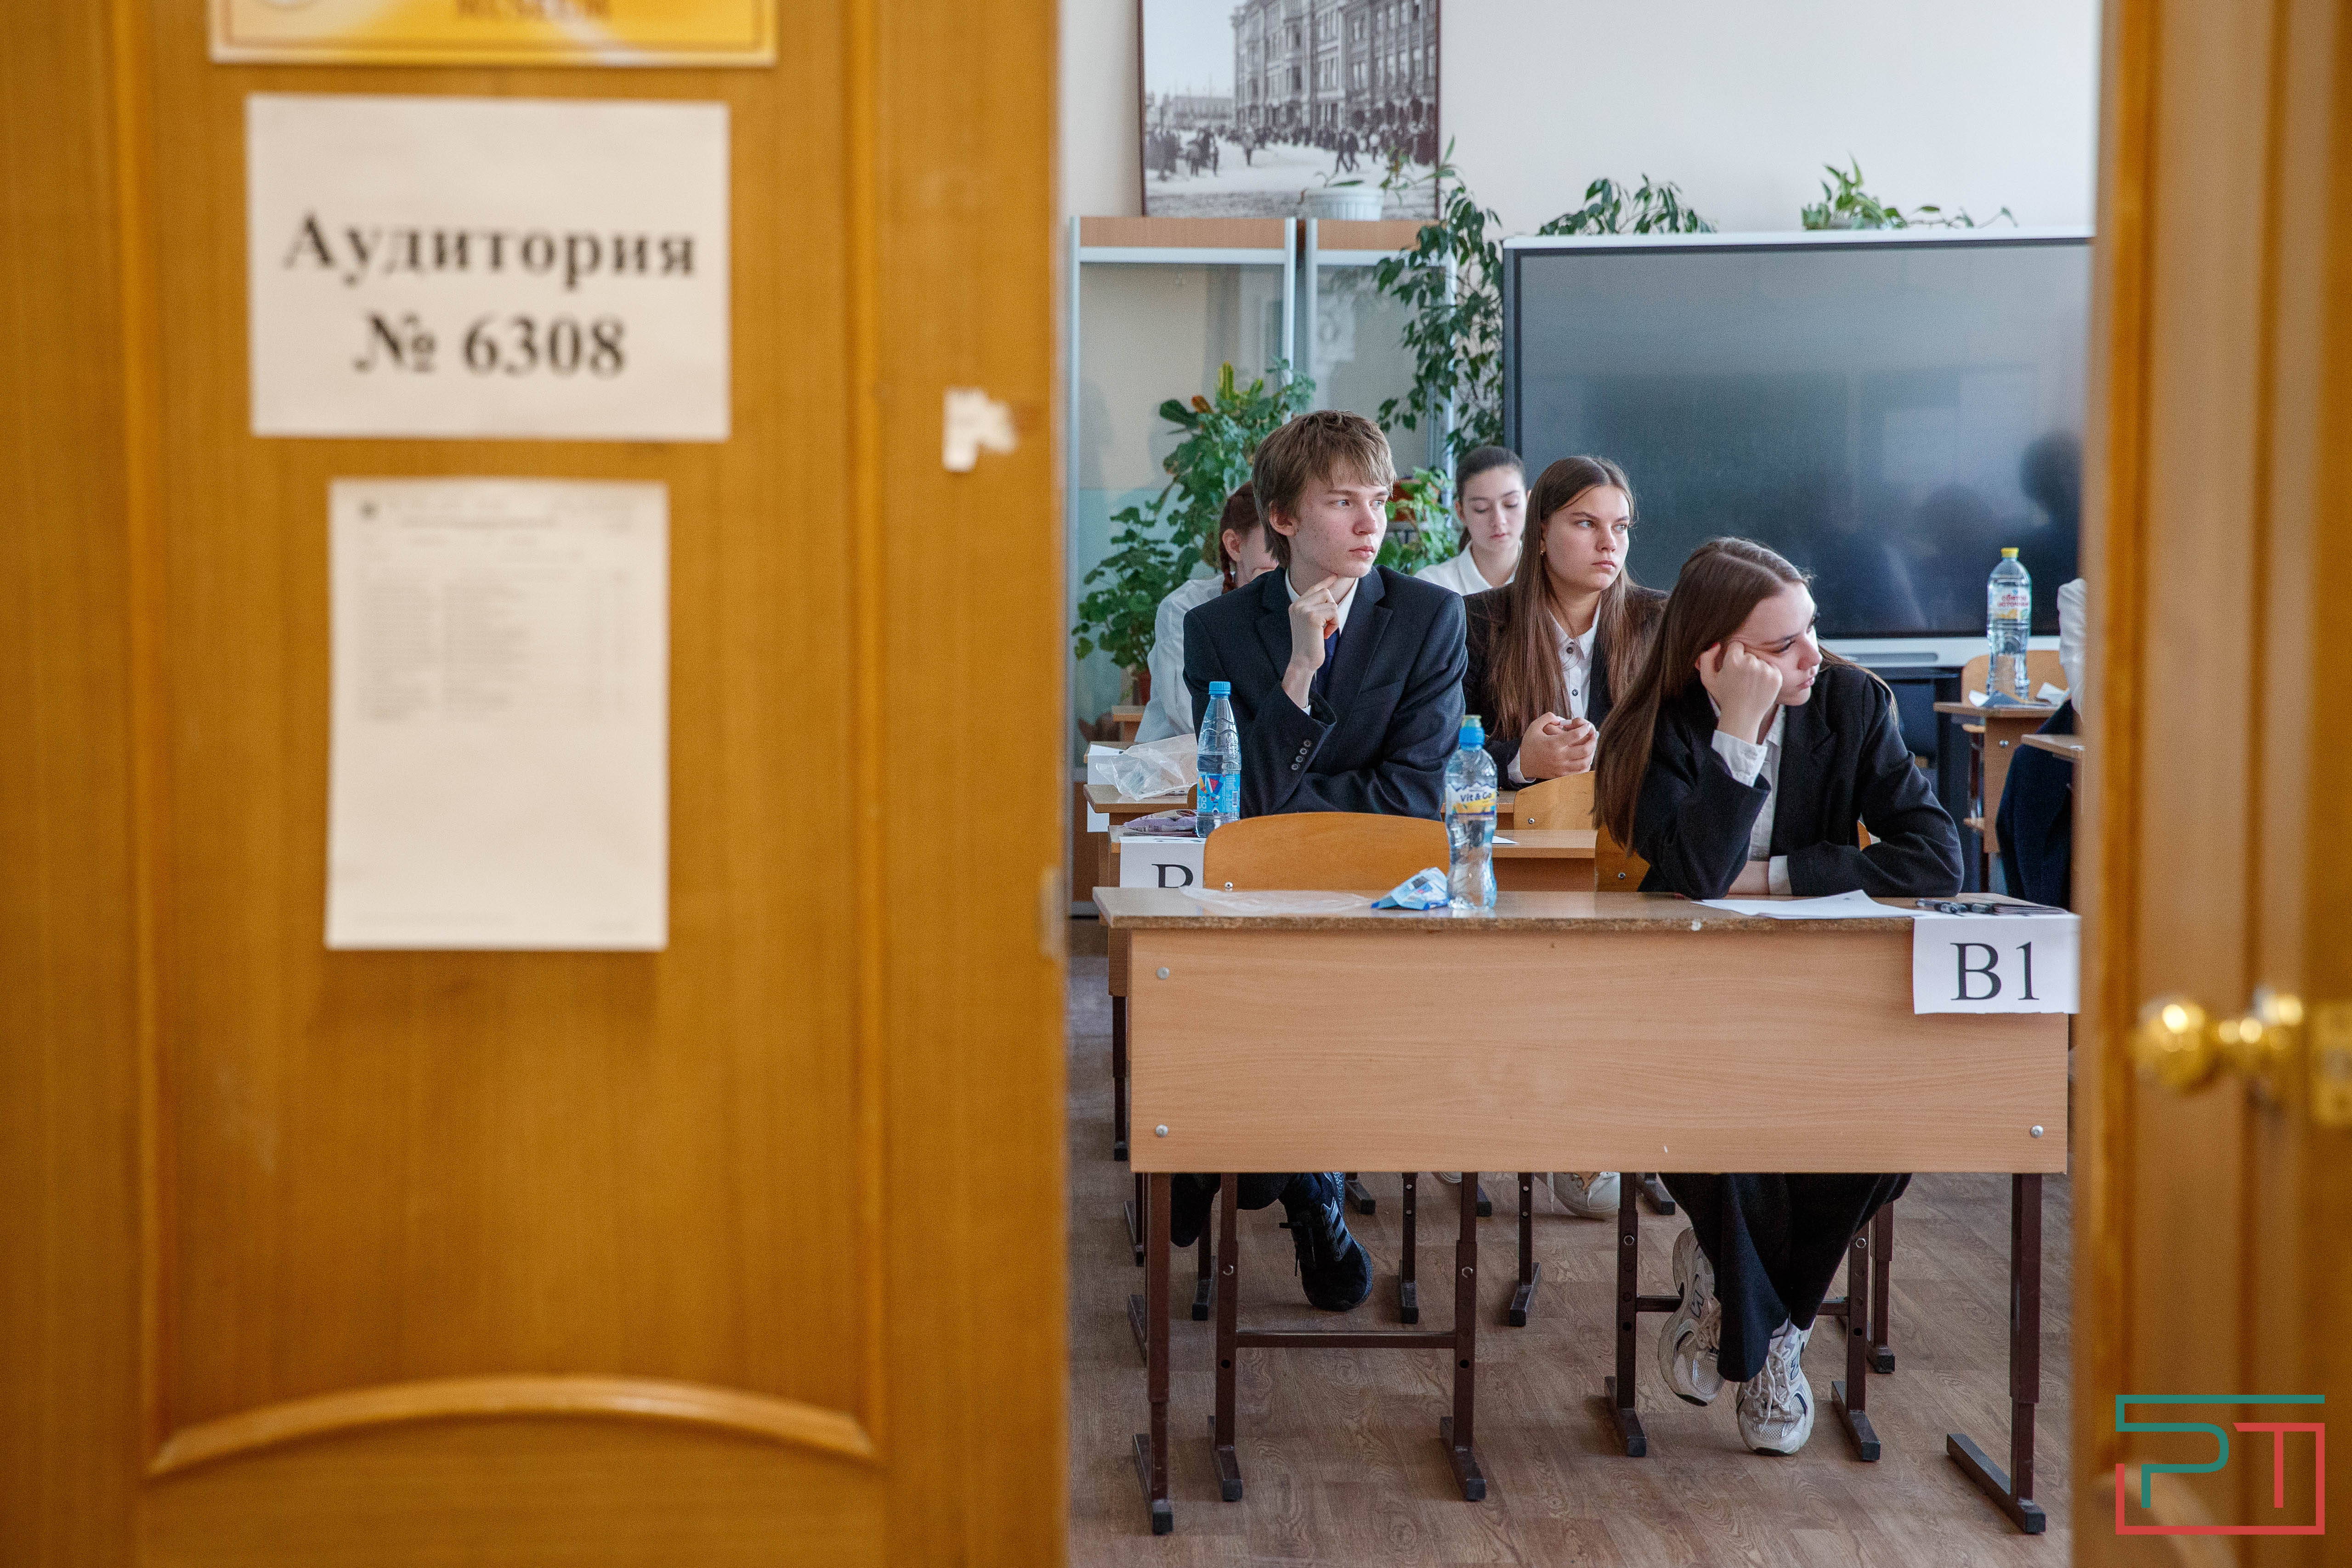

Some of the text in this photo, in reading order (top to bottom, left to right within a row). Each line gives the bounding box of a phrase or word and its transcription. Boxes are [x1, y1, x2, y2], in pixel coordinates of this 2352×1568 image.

[283, 209, 698, 292] Аудитория
[351, 310, 629, 377] № 6308
